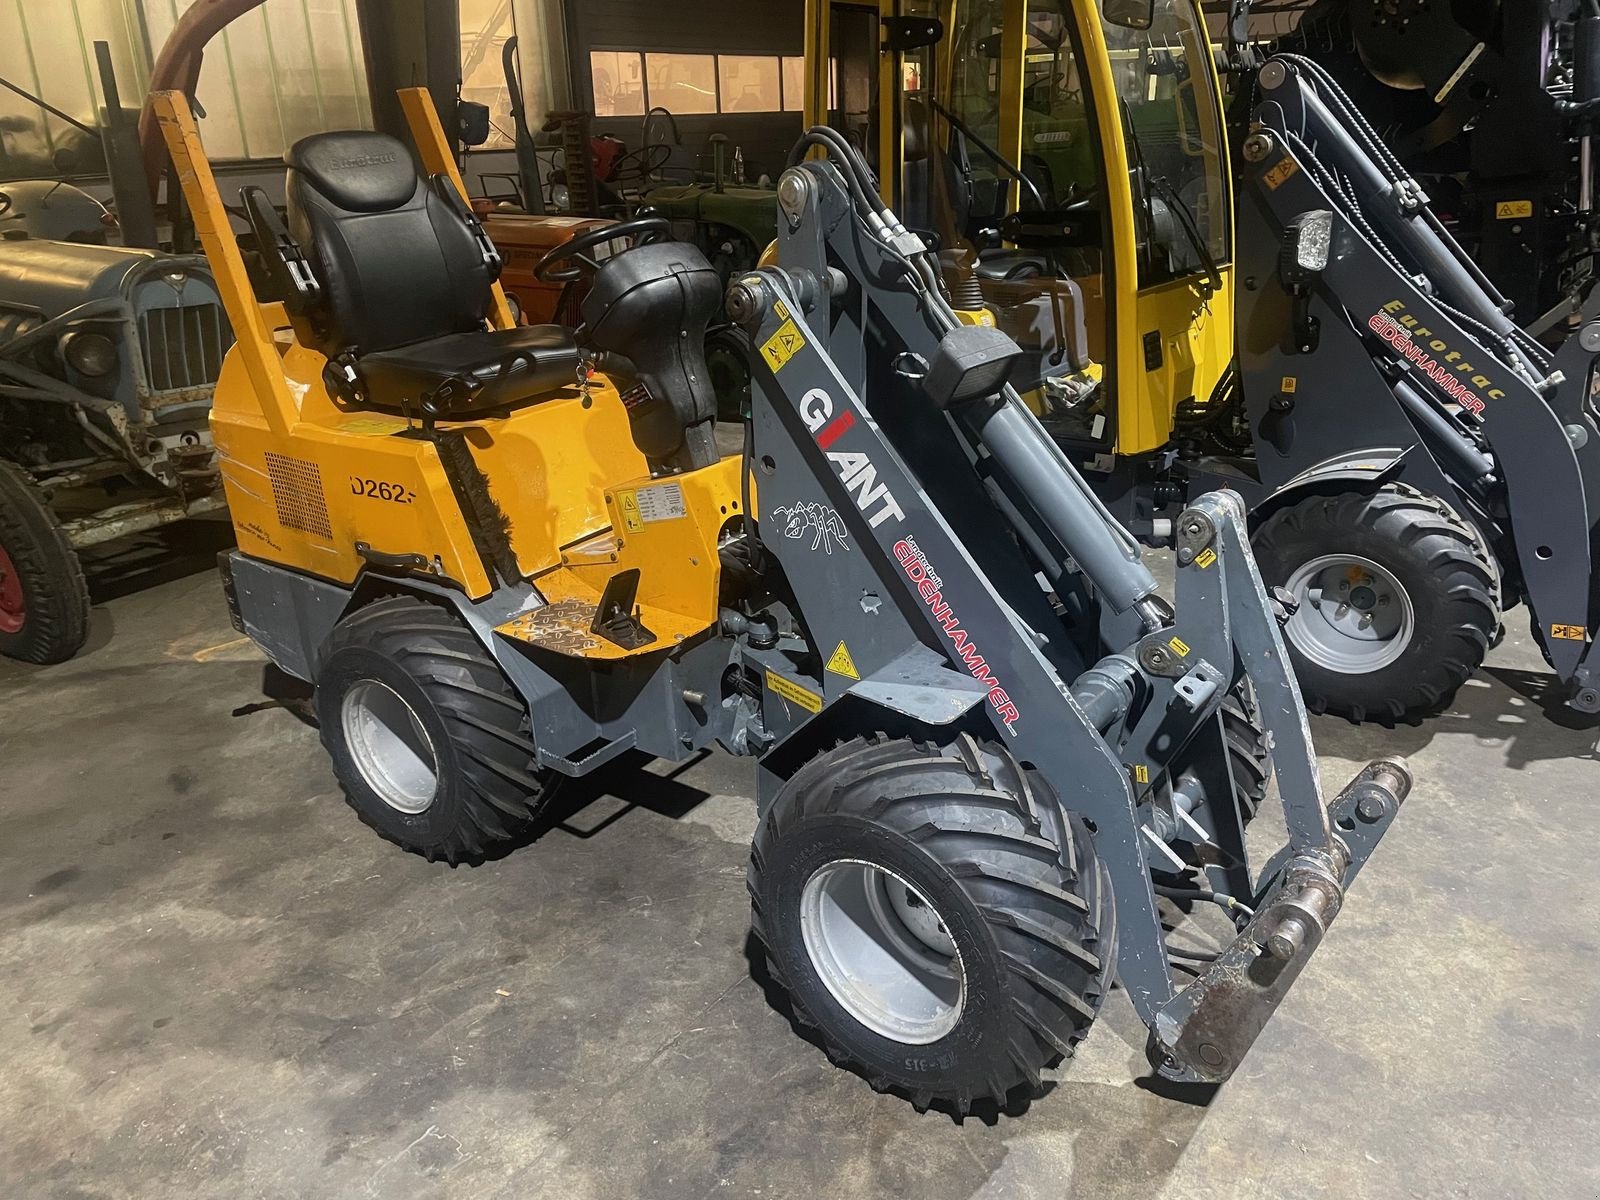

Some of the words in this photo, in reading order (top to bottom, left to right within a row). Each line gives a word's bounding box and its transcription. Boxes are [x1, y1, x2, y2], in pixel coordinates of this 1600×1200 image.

[1368, 314, 1485, 417] EIDENHAMMER
[1383, 300, 1506, 400] Eurotrac
[905, 534, 944, 590] Landtechnik
[892, 539, 1020, 725] EIDENHAMMER
